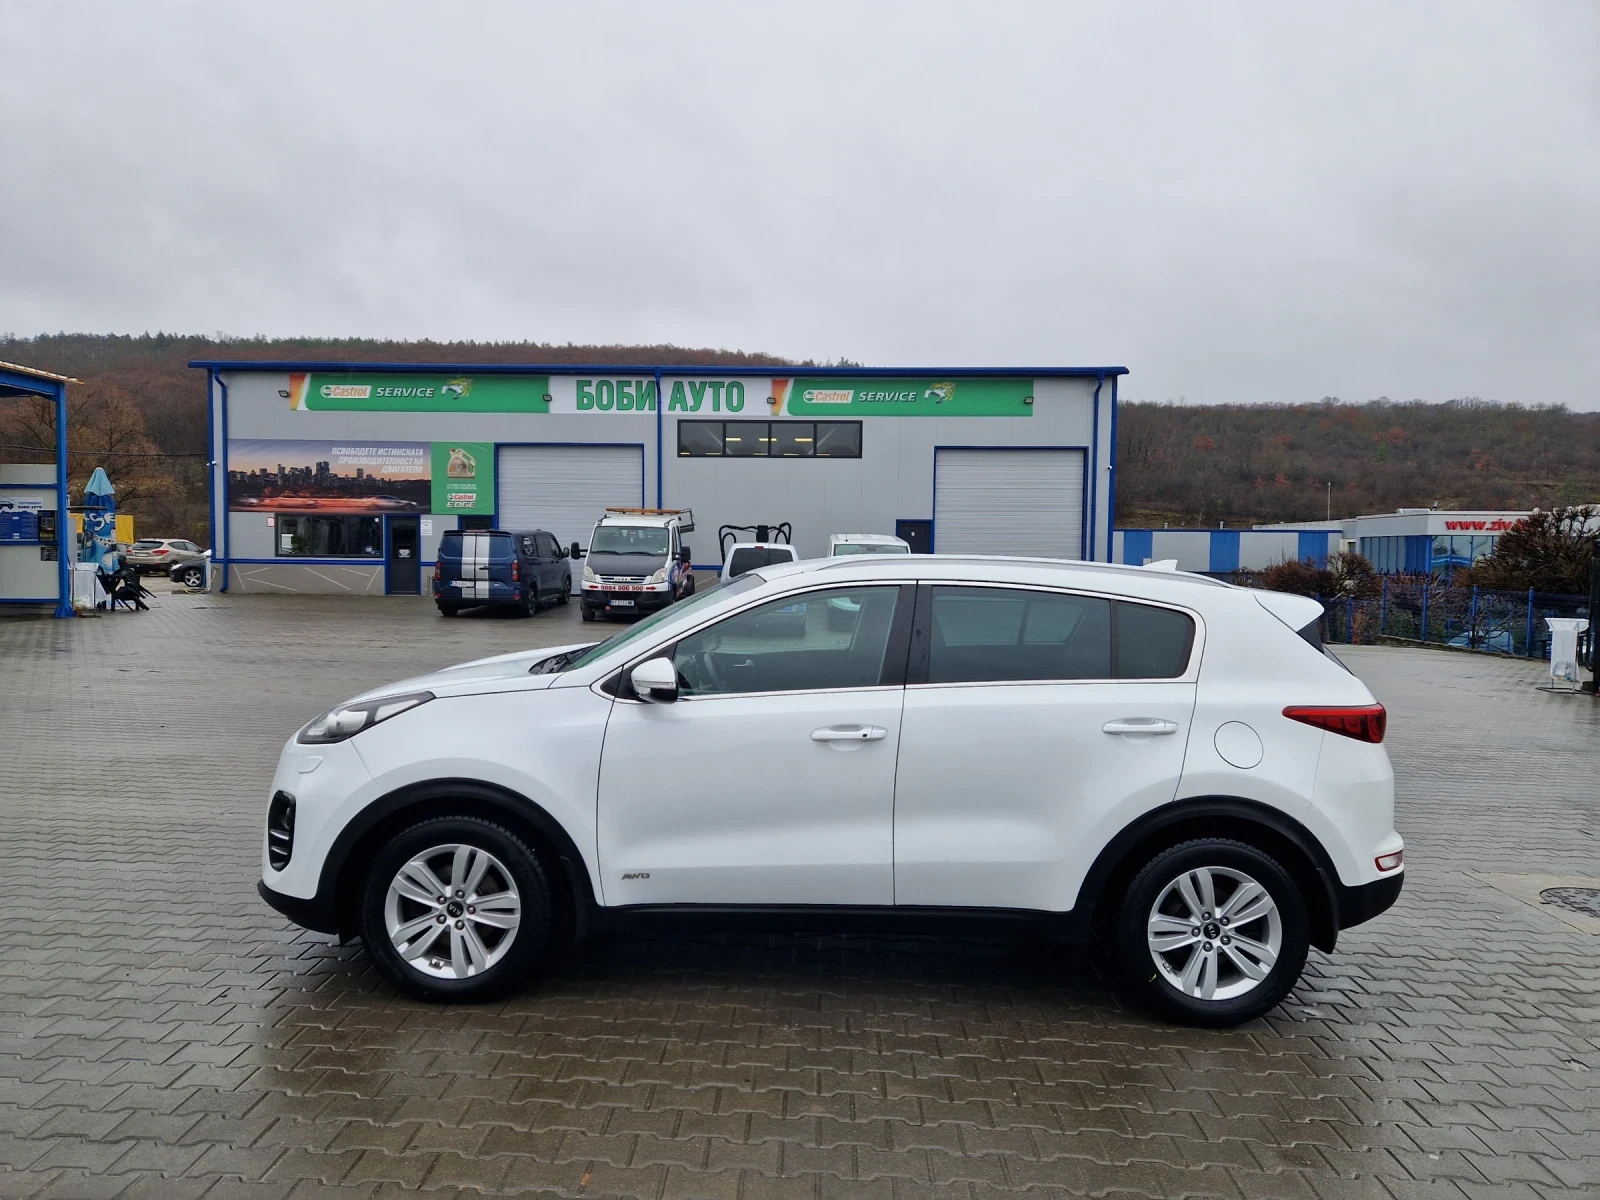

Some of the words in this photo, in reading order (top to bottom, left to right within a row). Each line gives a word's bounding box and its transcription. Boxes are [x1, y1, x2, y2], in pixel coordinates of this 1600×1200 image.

[333, 386, 368, 397] Castrol
[376, 387, 435, 398] SERVICE
[576, 380, 656, 411] БОБИ
[668, 381, 745, 412] АУТО
[815, 391, 851, 402] Castrol
[859, 392, 917, 402] SERVICE
[332, 447, 377, 456] ОСВОБОДЕТЕ
[377, 448, 423, 456] ИСТИНСКАТА
[453, 493, 474, 501] Castrol
